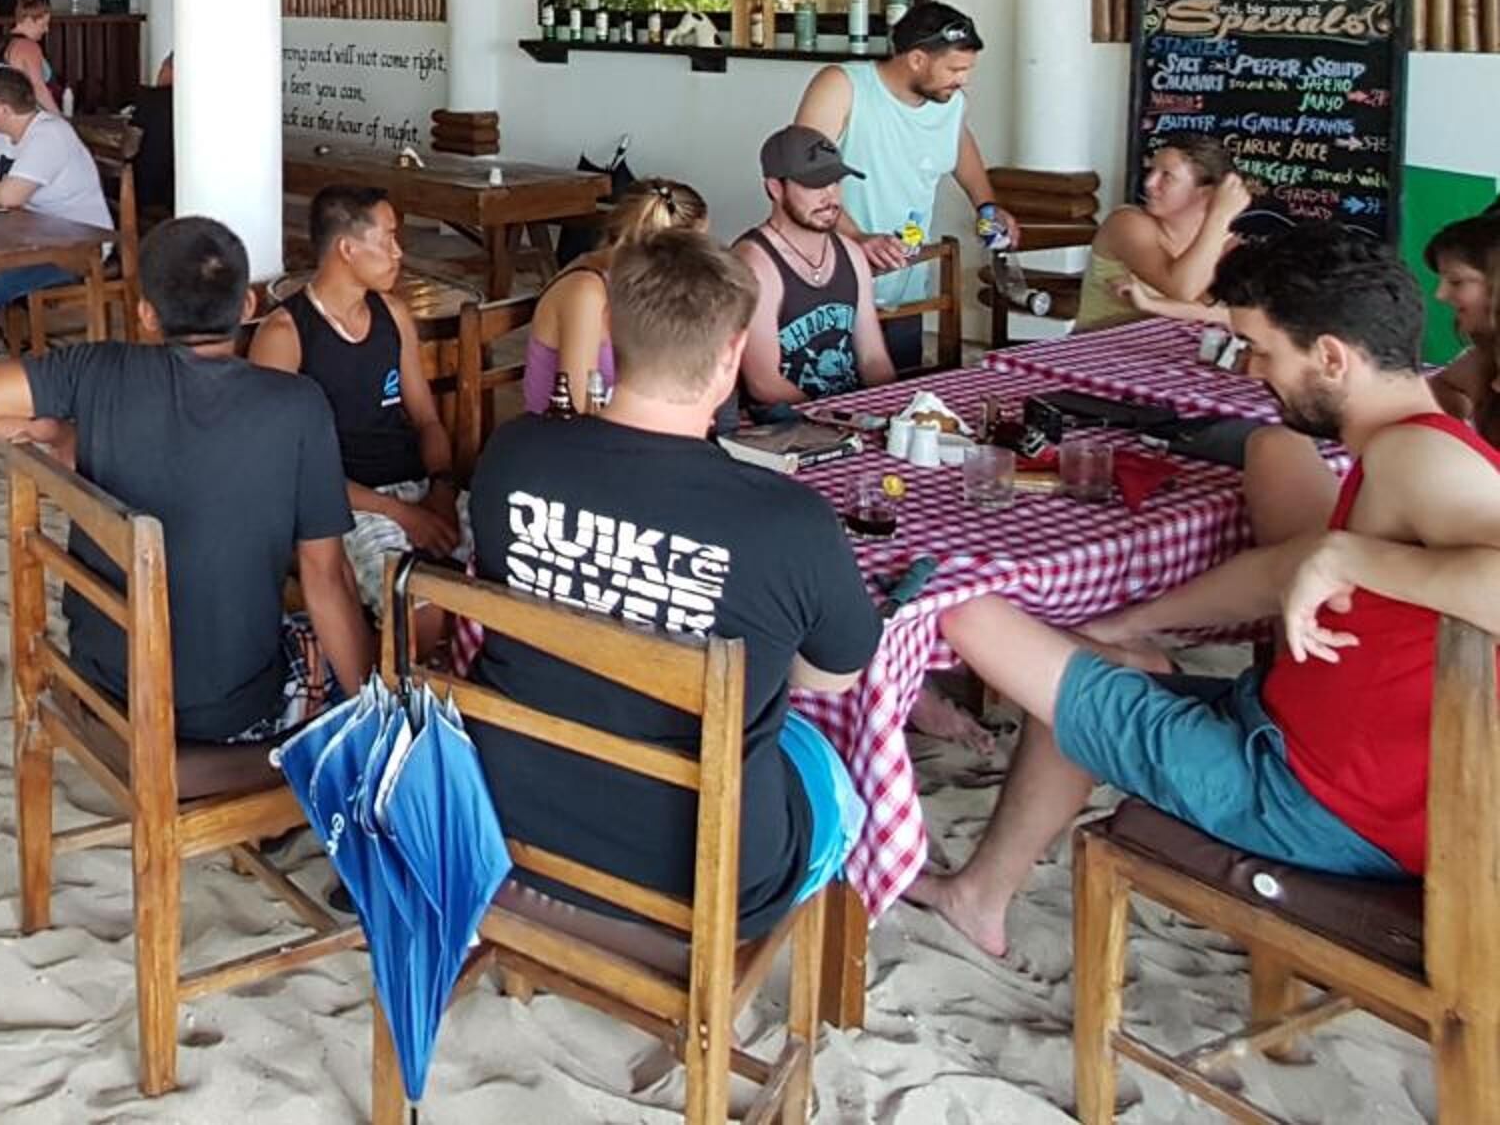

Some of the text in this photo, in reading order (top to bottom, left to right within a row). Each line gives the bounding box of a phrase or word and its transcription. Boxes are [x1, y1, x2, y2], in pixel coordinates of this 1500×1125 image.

[310, 43, 332, 64] and
[334, 44, 356, 65] will
[358, 49, 378, 67] not
[382, 52, 410, 69] come
[1228, 55, 1300, 78] PEPPER
[291, 74, 311, 96] best
[315, 82, 338, 105] you
[1298, 92, 1344, 112] MAYO
[317, 110, 335, 131] the
[337, 111, 362, 134] hour
[366, 116, 380, 145] of
[1153, 114, 1216, 133] BUTTER
[1242, 113, 1293, 133] GARLIC
[1224, 134, 1281, 156] GARLIC
[1286, 139, 1329, 162] RICE
[1274, 185, 1340, 204] GARDEN
